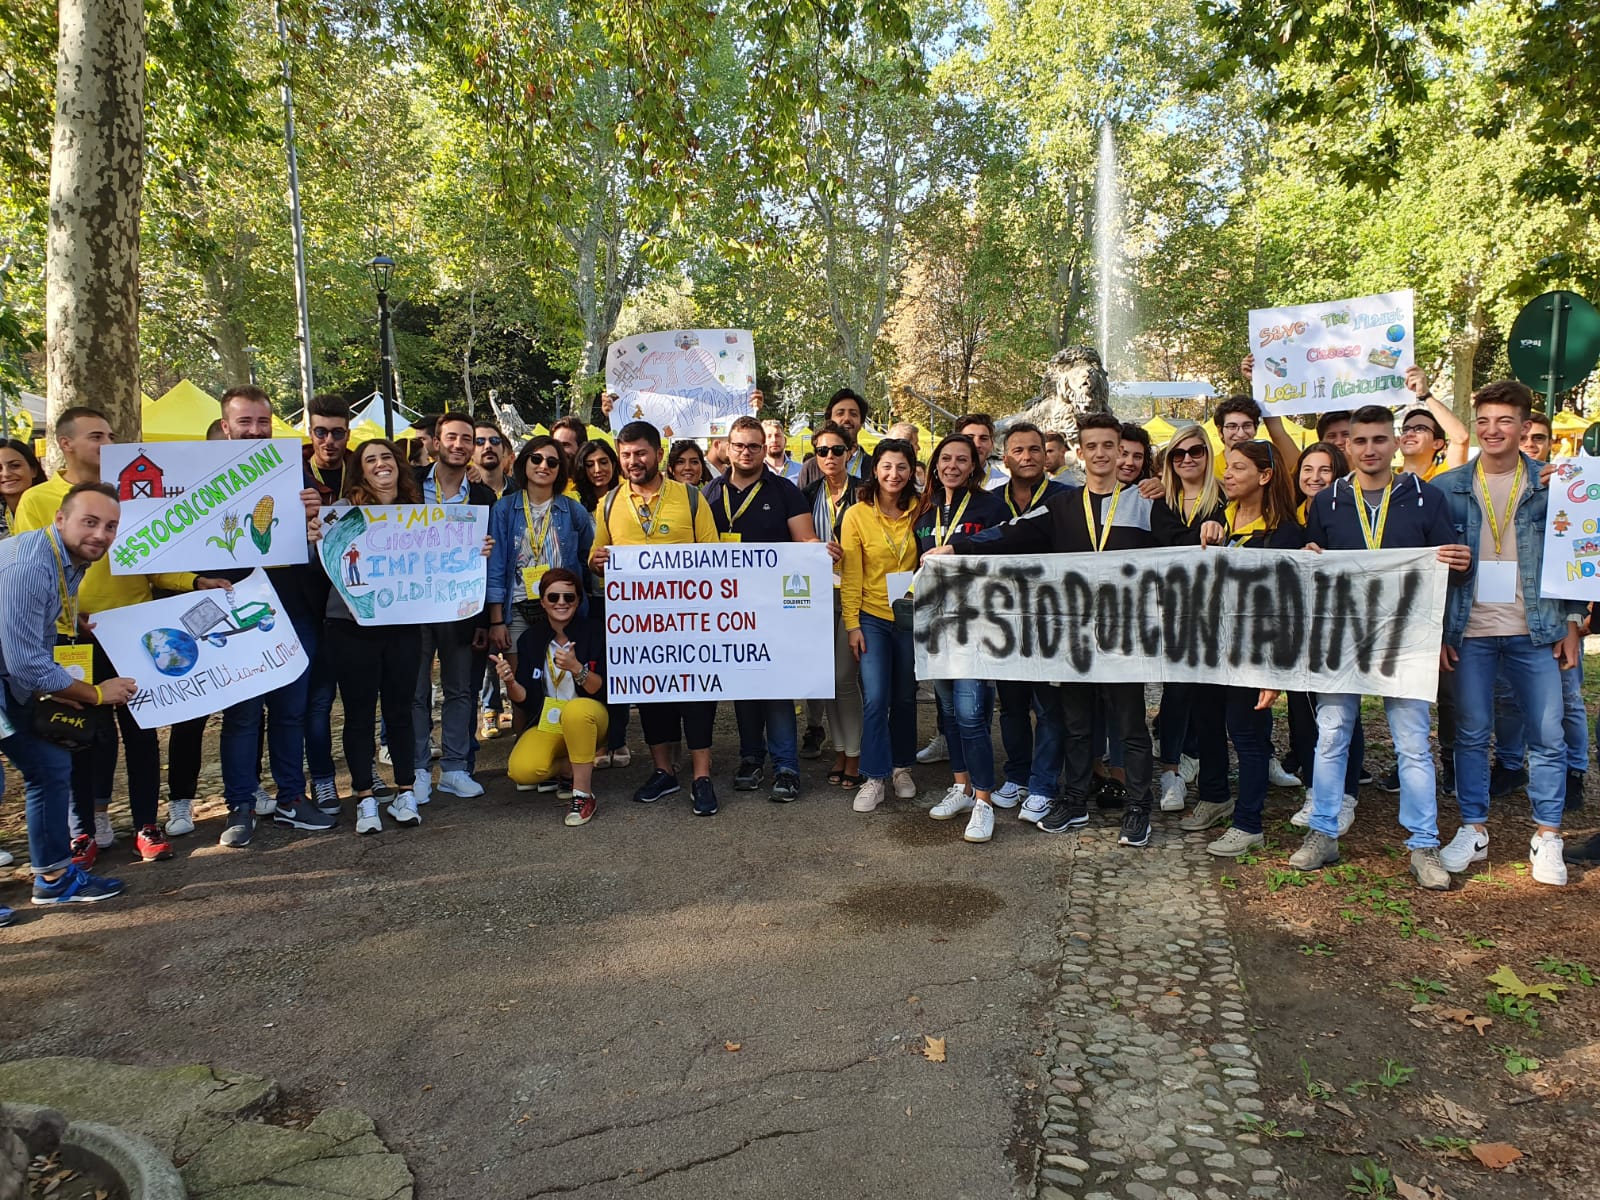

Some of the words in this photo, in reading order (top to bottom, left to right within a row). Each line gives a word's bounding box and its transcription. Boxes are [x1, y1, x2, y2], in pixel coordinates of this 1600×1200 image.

[113, 443, 284, 569] #STOCOICONTADINI
[366, 546, 482, 579] IMPRESA
[607, 552, 623, 571] IL
[638, 549, 778, 570] CAMBIAMENTO
[606, 579, 713, 602] CLIMATICO
[720, 579, 738, 599] SI
[607, 612, 711, 634] COMBATTE
[717, 611, 756, 633] CON
[609, 643, 772, 665] UN'AGRICOLTURA
[610, 673, 723, 695] INNOVATIVA
